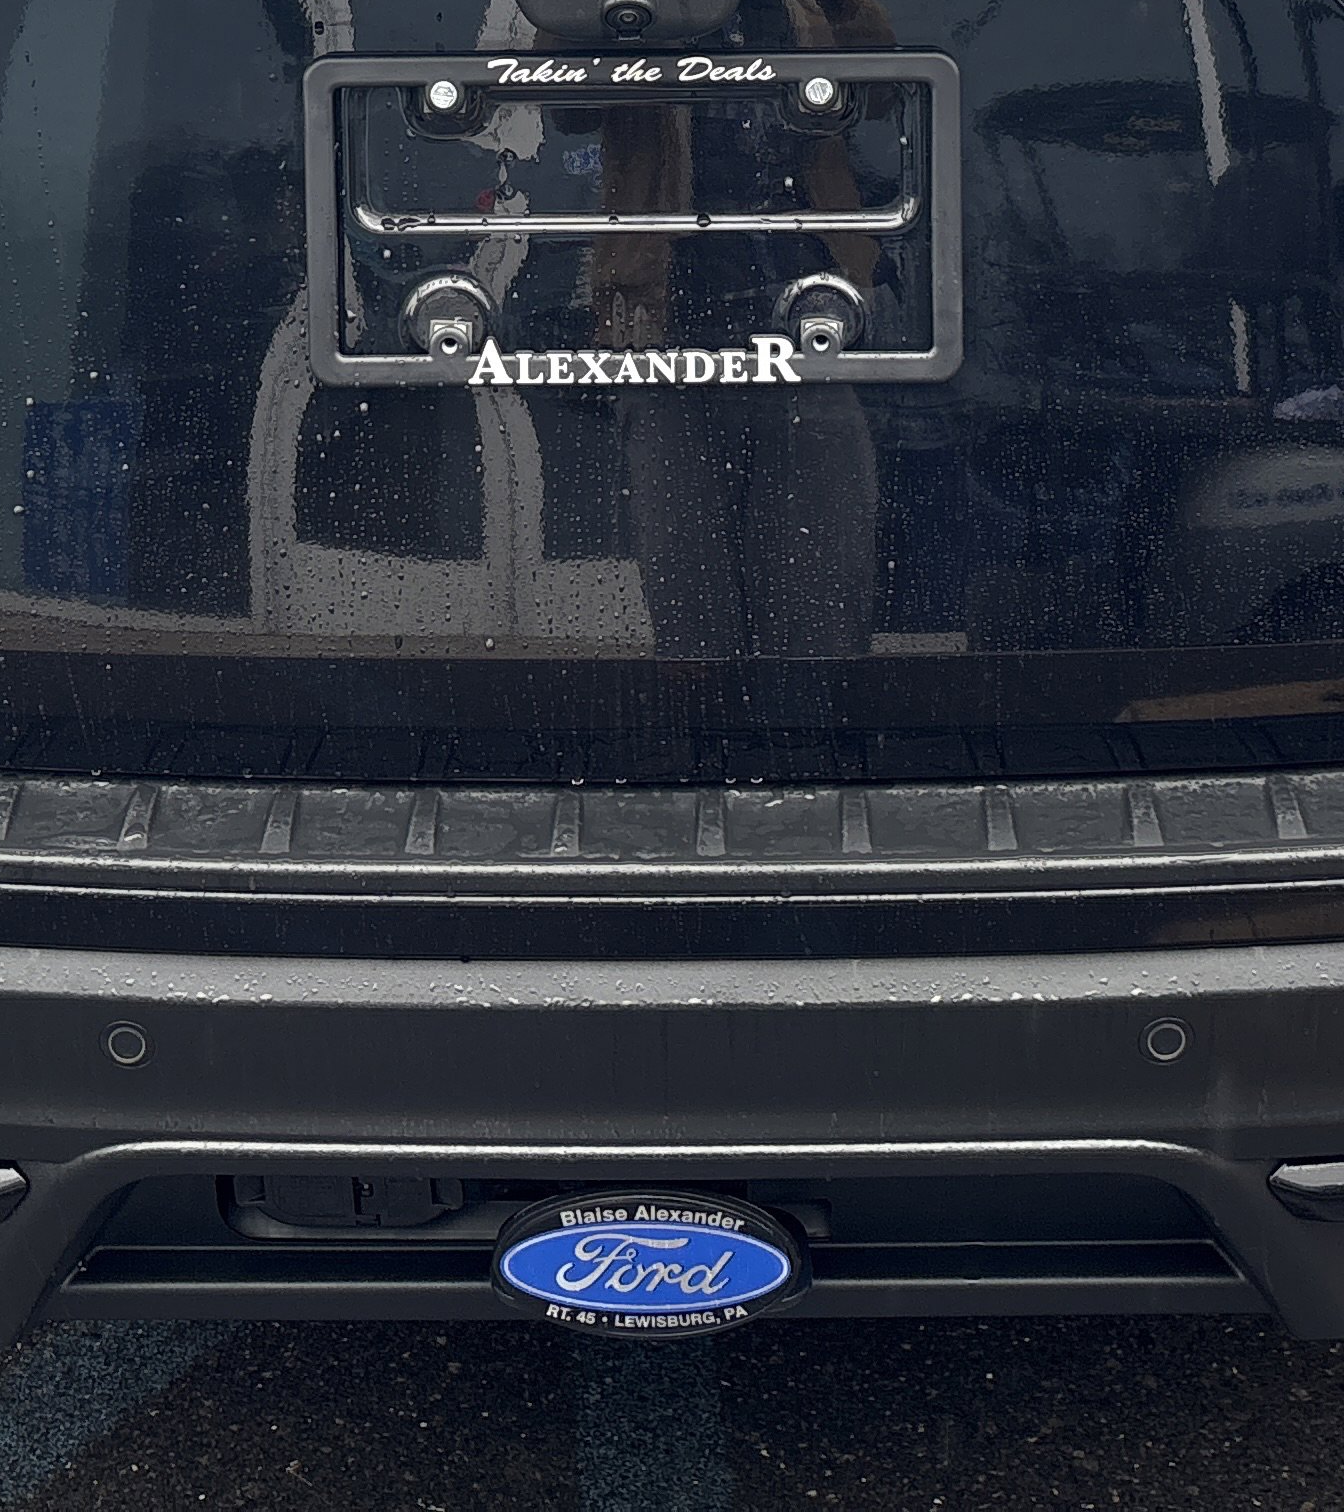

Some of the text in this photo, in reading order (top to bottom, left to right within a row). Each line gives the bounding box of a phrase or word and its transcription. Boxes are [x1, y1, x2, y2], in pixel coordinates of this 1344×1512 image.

[487, 56, 777, 84] Takin' the Deals
[559, 1205, 745, 1232] Blaise Alexander
[555, 1232, 735, 1295] Ford
[545, 1303, 749, 1329] RT. 45 LEWISBURG, PA
